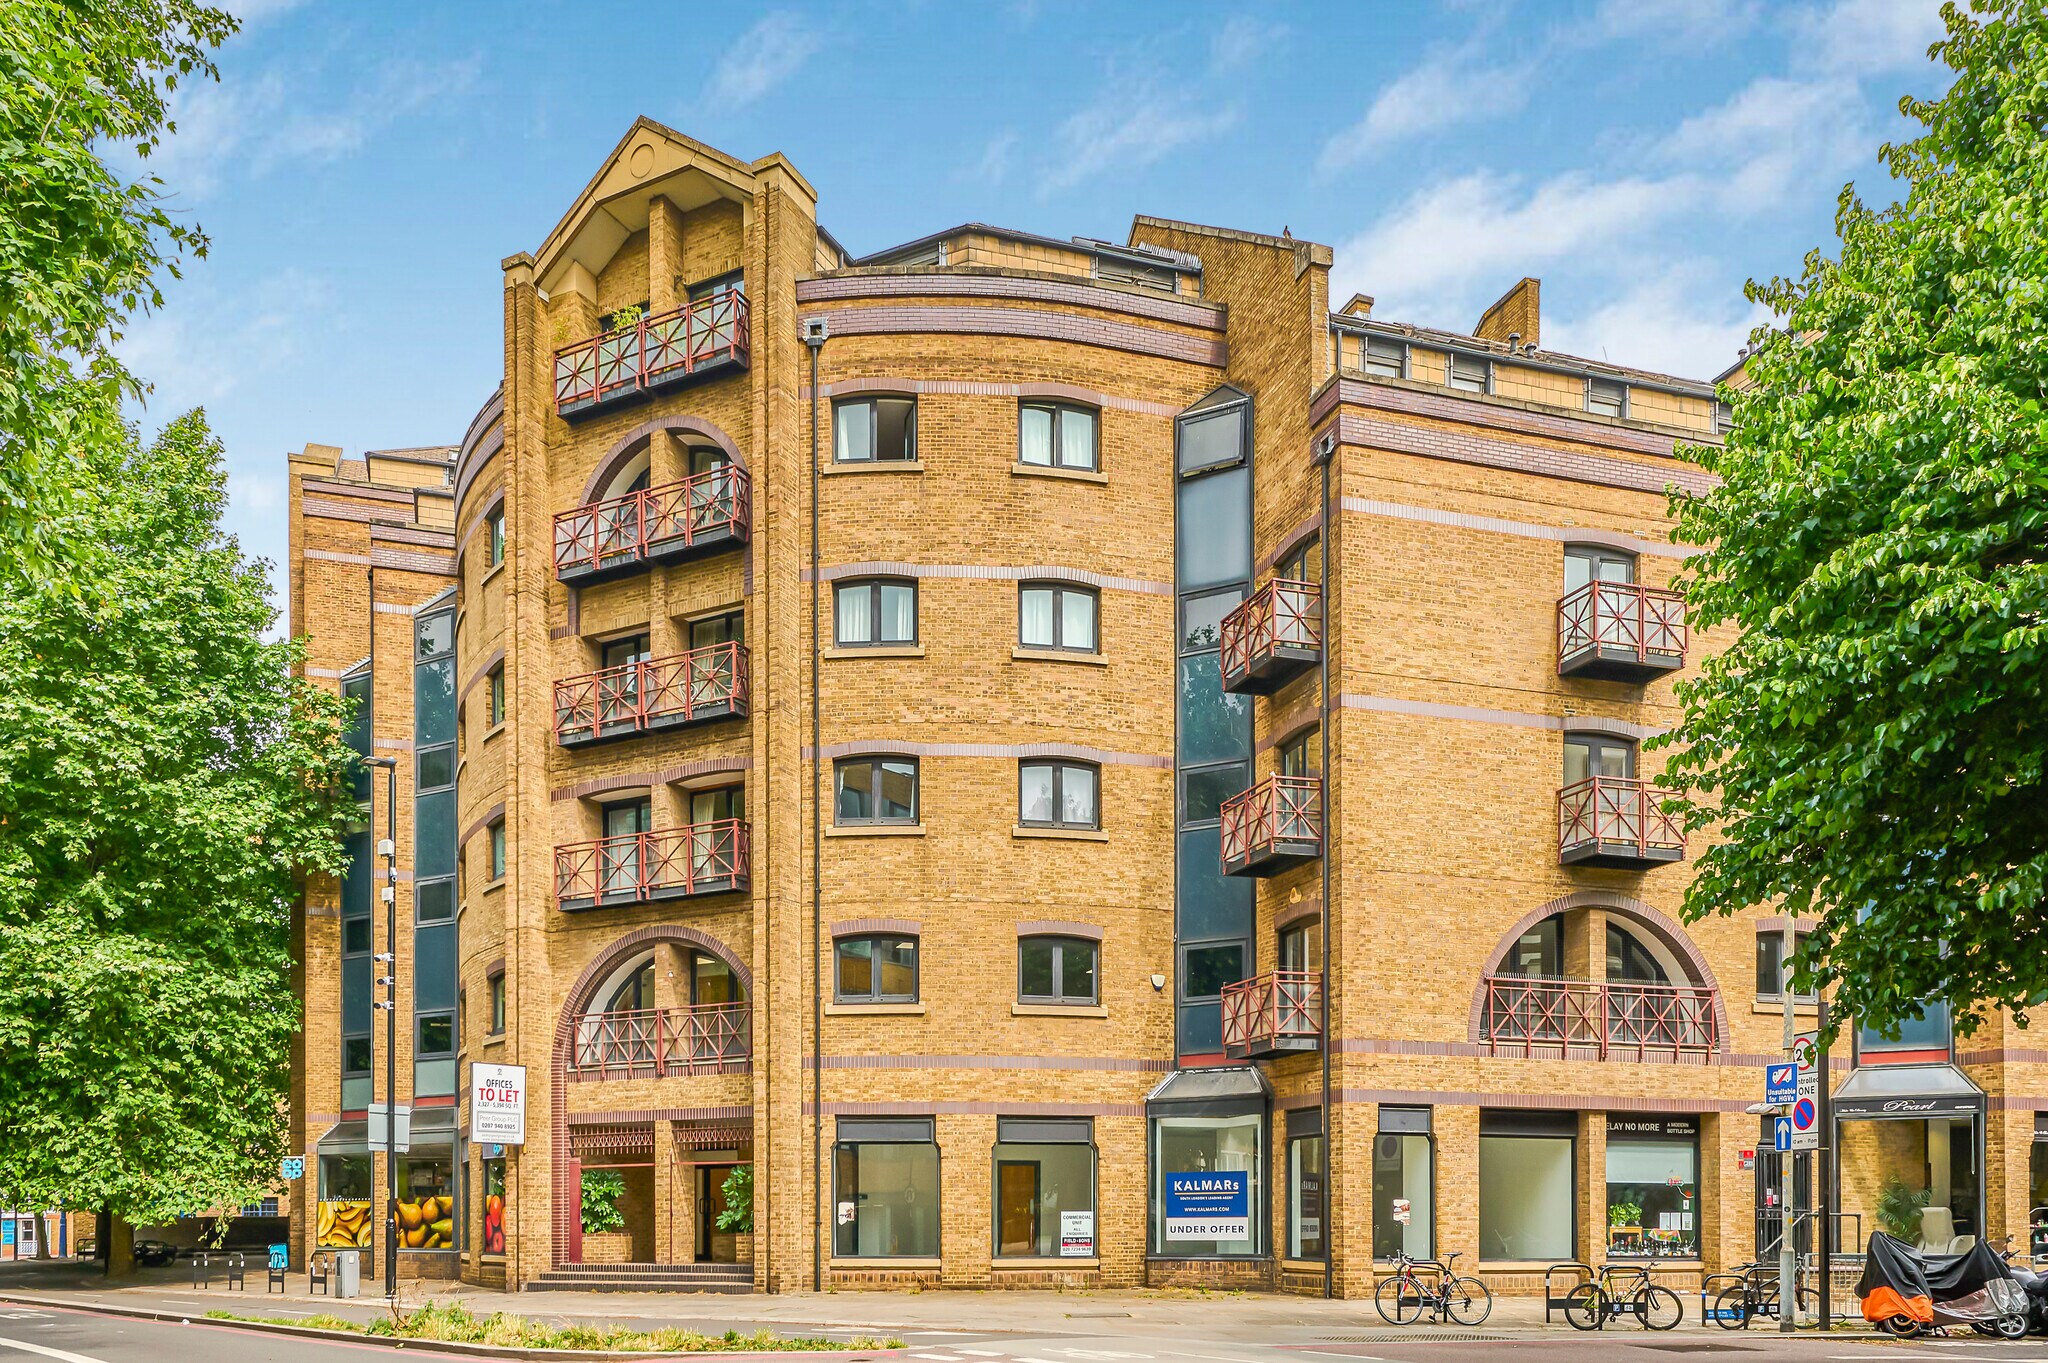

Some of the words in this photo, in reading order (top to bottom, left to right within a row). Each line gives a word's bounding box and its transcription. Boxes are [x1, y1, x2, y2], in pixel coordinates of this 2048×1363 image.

[486, 1079, 512, 1088] OFFICES
[479, 1088, 495, 1101] TO
[499, 1089, 519, 1102] LET
[1798, 1086, 1815, 1095] ONE
[1883, 1100, 1936, 1111] Pearl
[1607, 1122, 1624, 1131] ELAY
[1625, 1123, 1636, 1131] NO
[1638, 1123, 1659, 1131] MORE
[1174, 1180, 1239, 1191] KALMARs
[1210, 1225, 1244, 1233] OFFER
